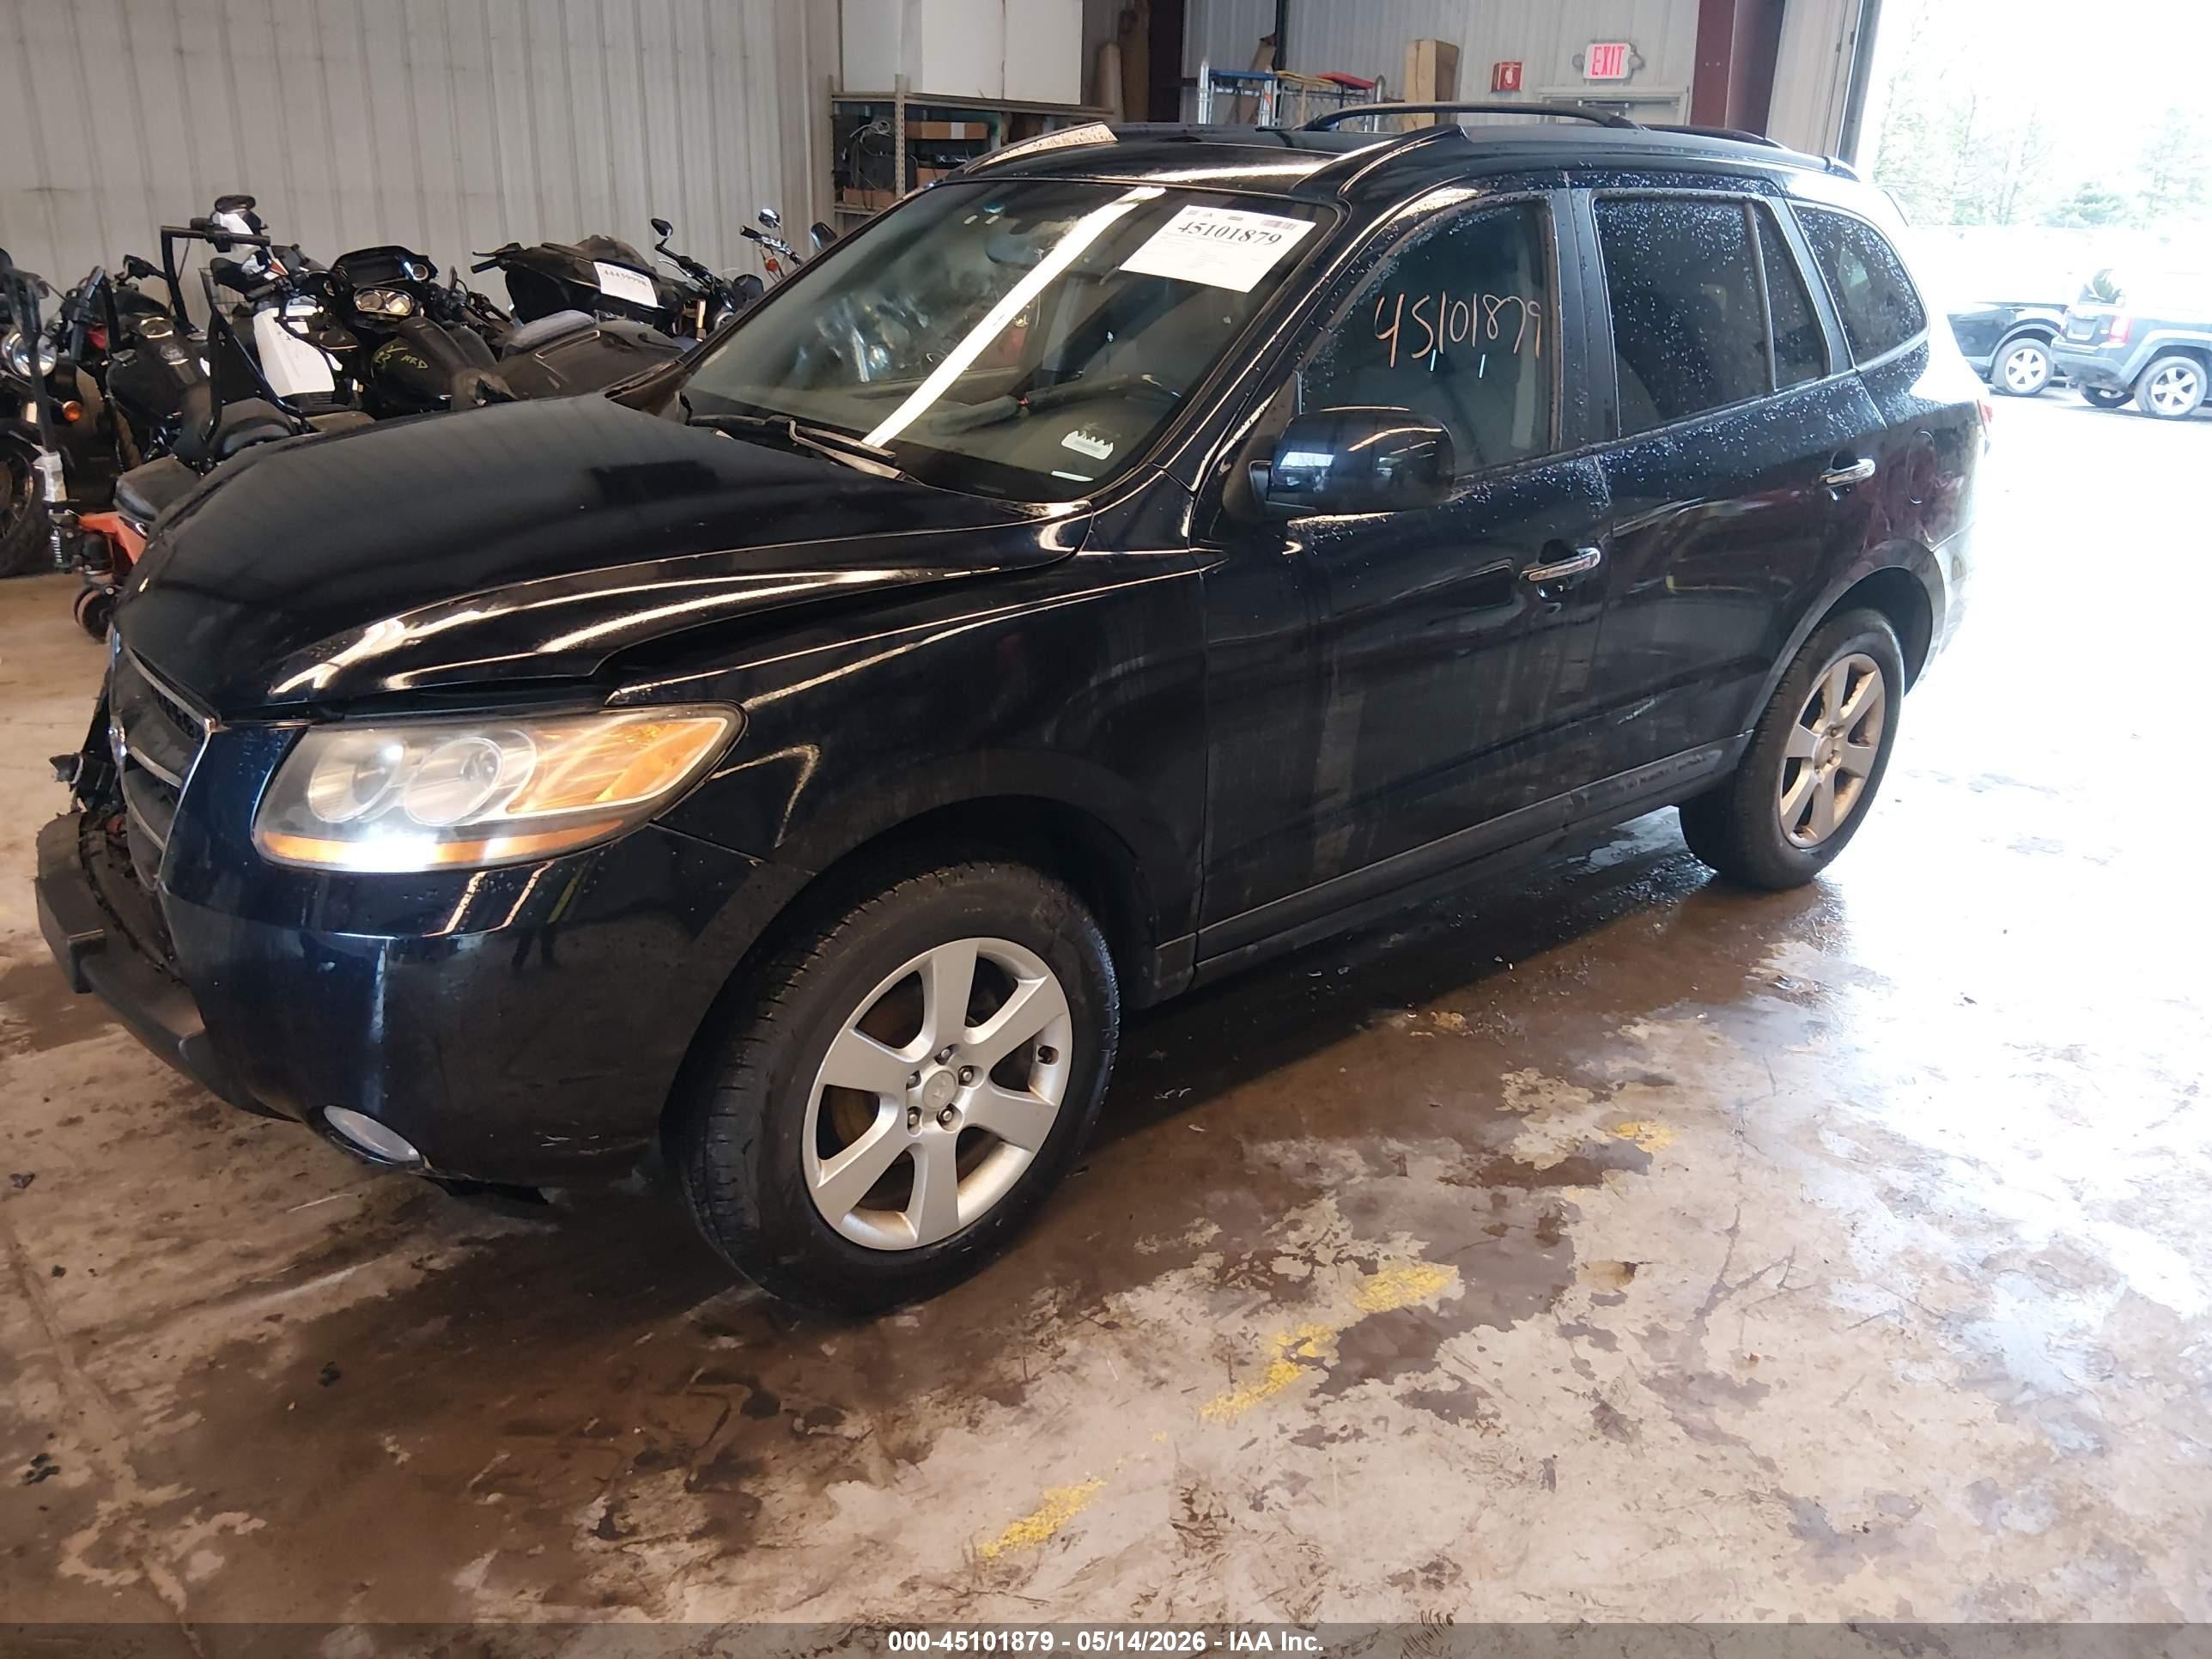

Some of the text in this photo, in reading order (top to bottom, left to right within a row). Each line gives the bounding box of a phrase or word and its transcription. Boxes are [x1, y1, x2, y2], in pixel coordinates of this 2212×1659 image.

[1591, 46, 1625, 76] EXIT
[1177, 221, 1282, 246] 45101879
[1374, 290, 1541, 368] 45101879
